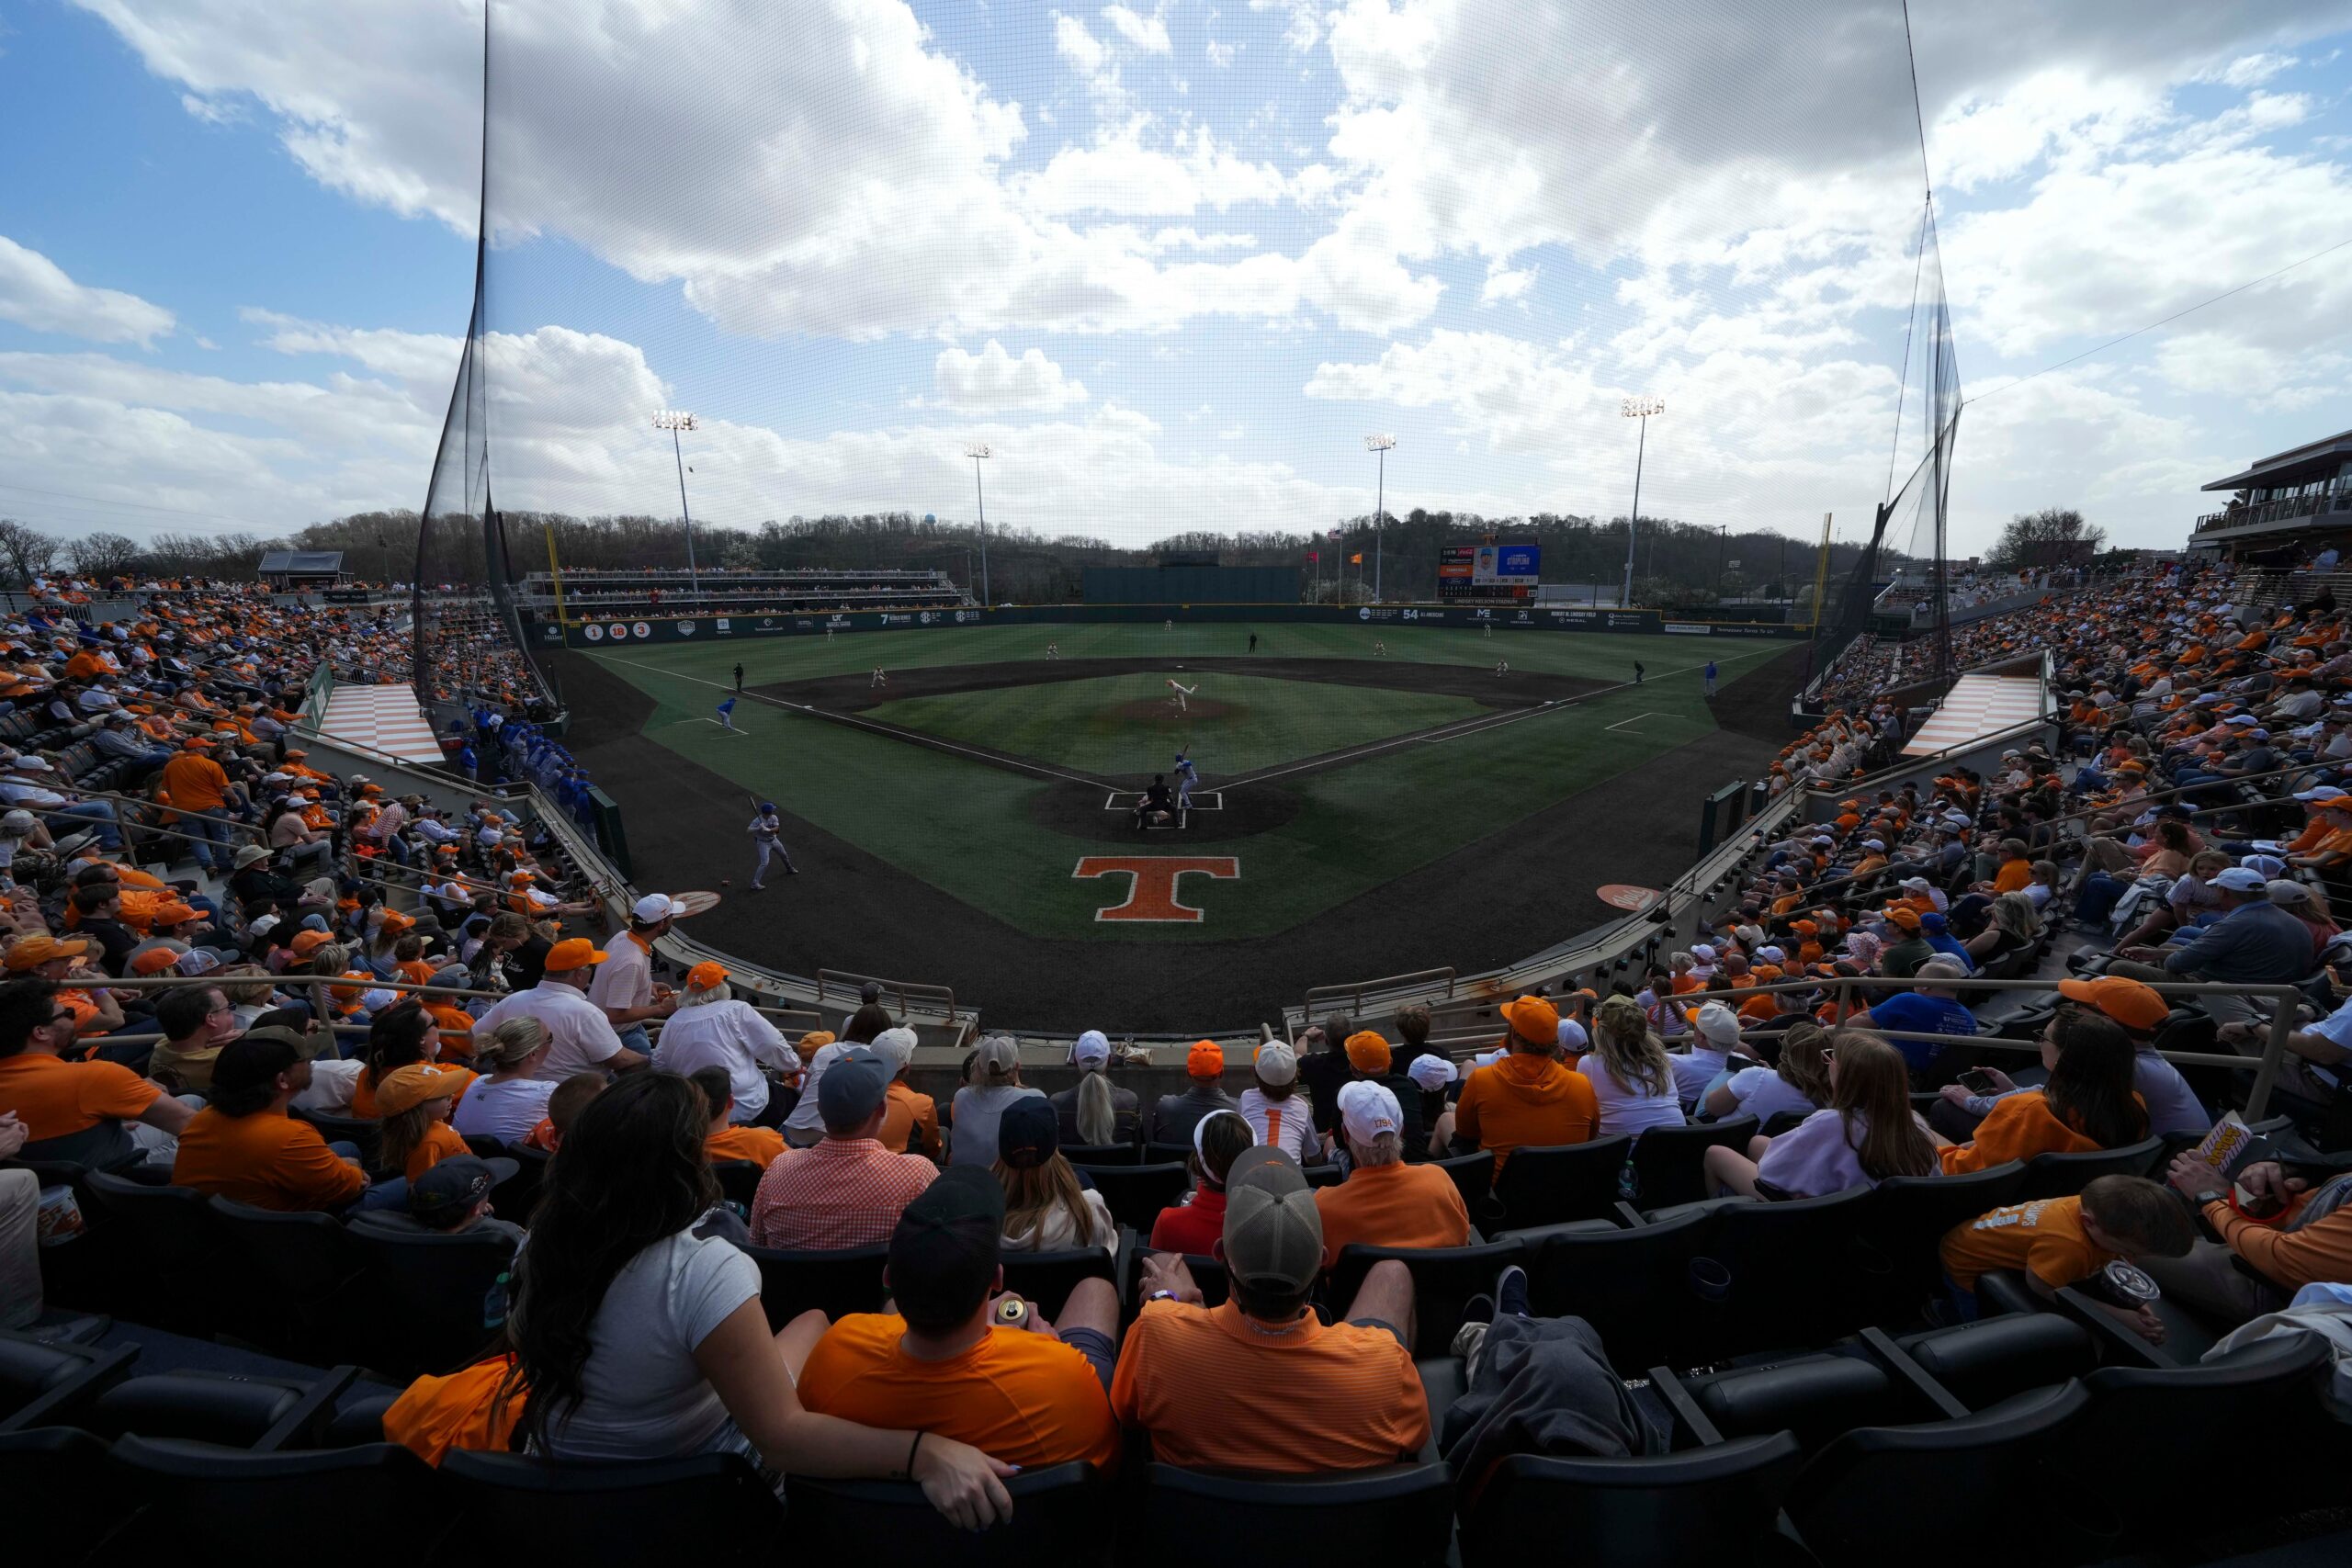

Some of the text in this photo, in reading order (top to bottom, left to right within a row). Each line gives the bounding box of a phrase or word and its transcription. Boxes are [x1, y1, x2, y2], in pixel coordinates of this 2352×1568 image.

[1403, 609, 1419, 619] 54
[880, 615, 888, 625] 7
[592, 628, 598, 637] 1
[612, 627, 625, 636] 18
[1071, 856, 1240, 923] T
[1265, 1108, 1283, 1147] 1
[1374, 1119, 1394, 1129] 1794
